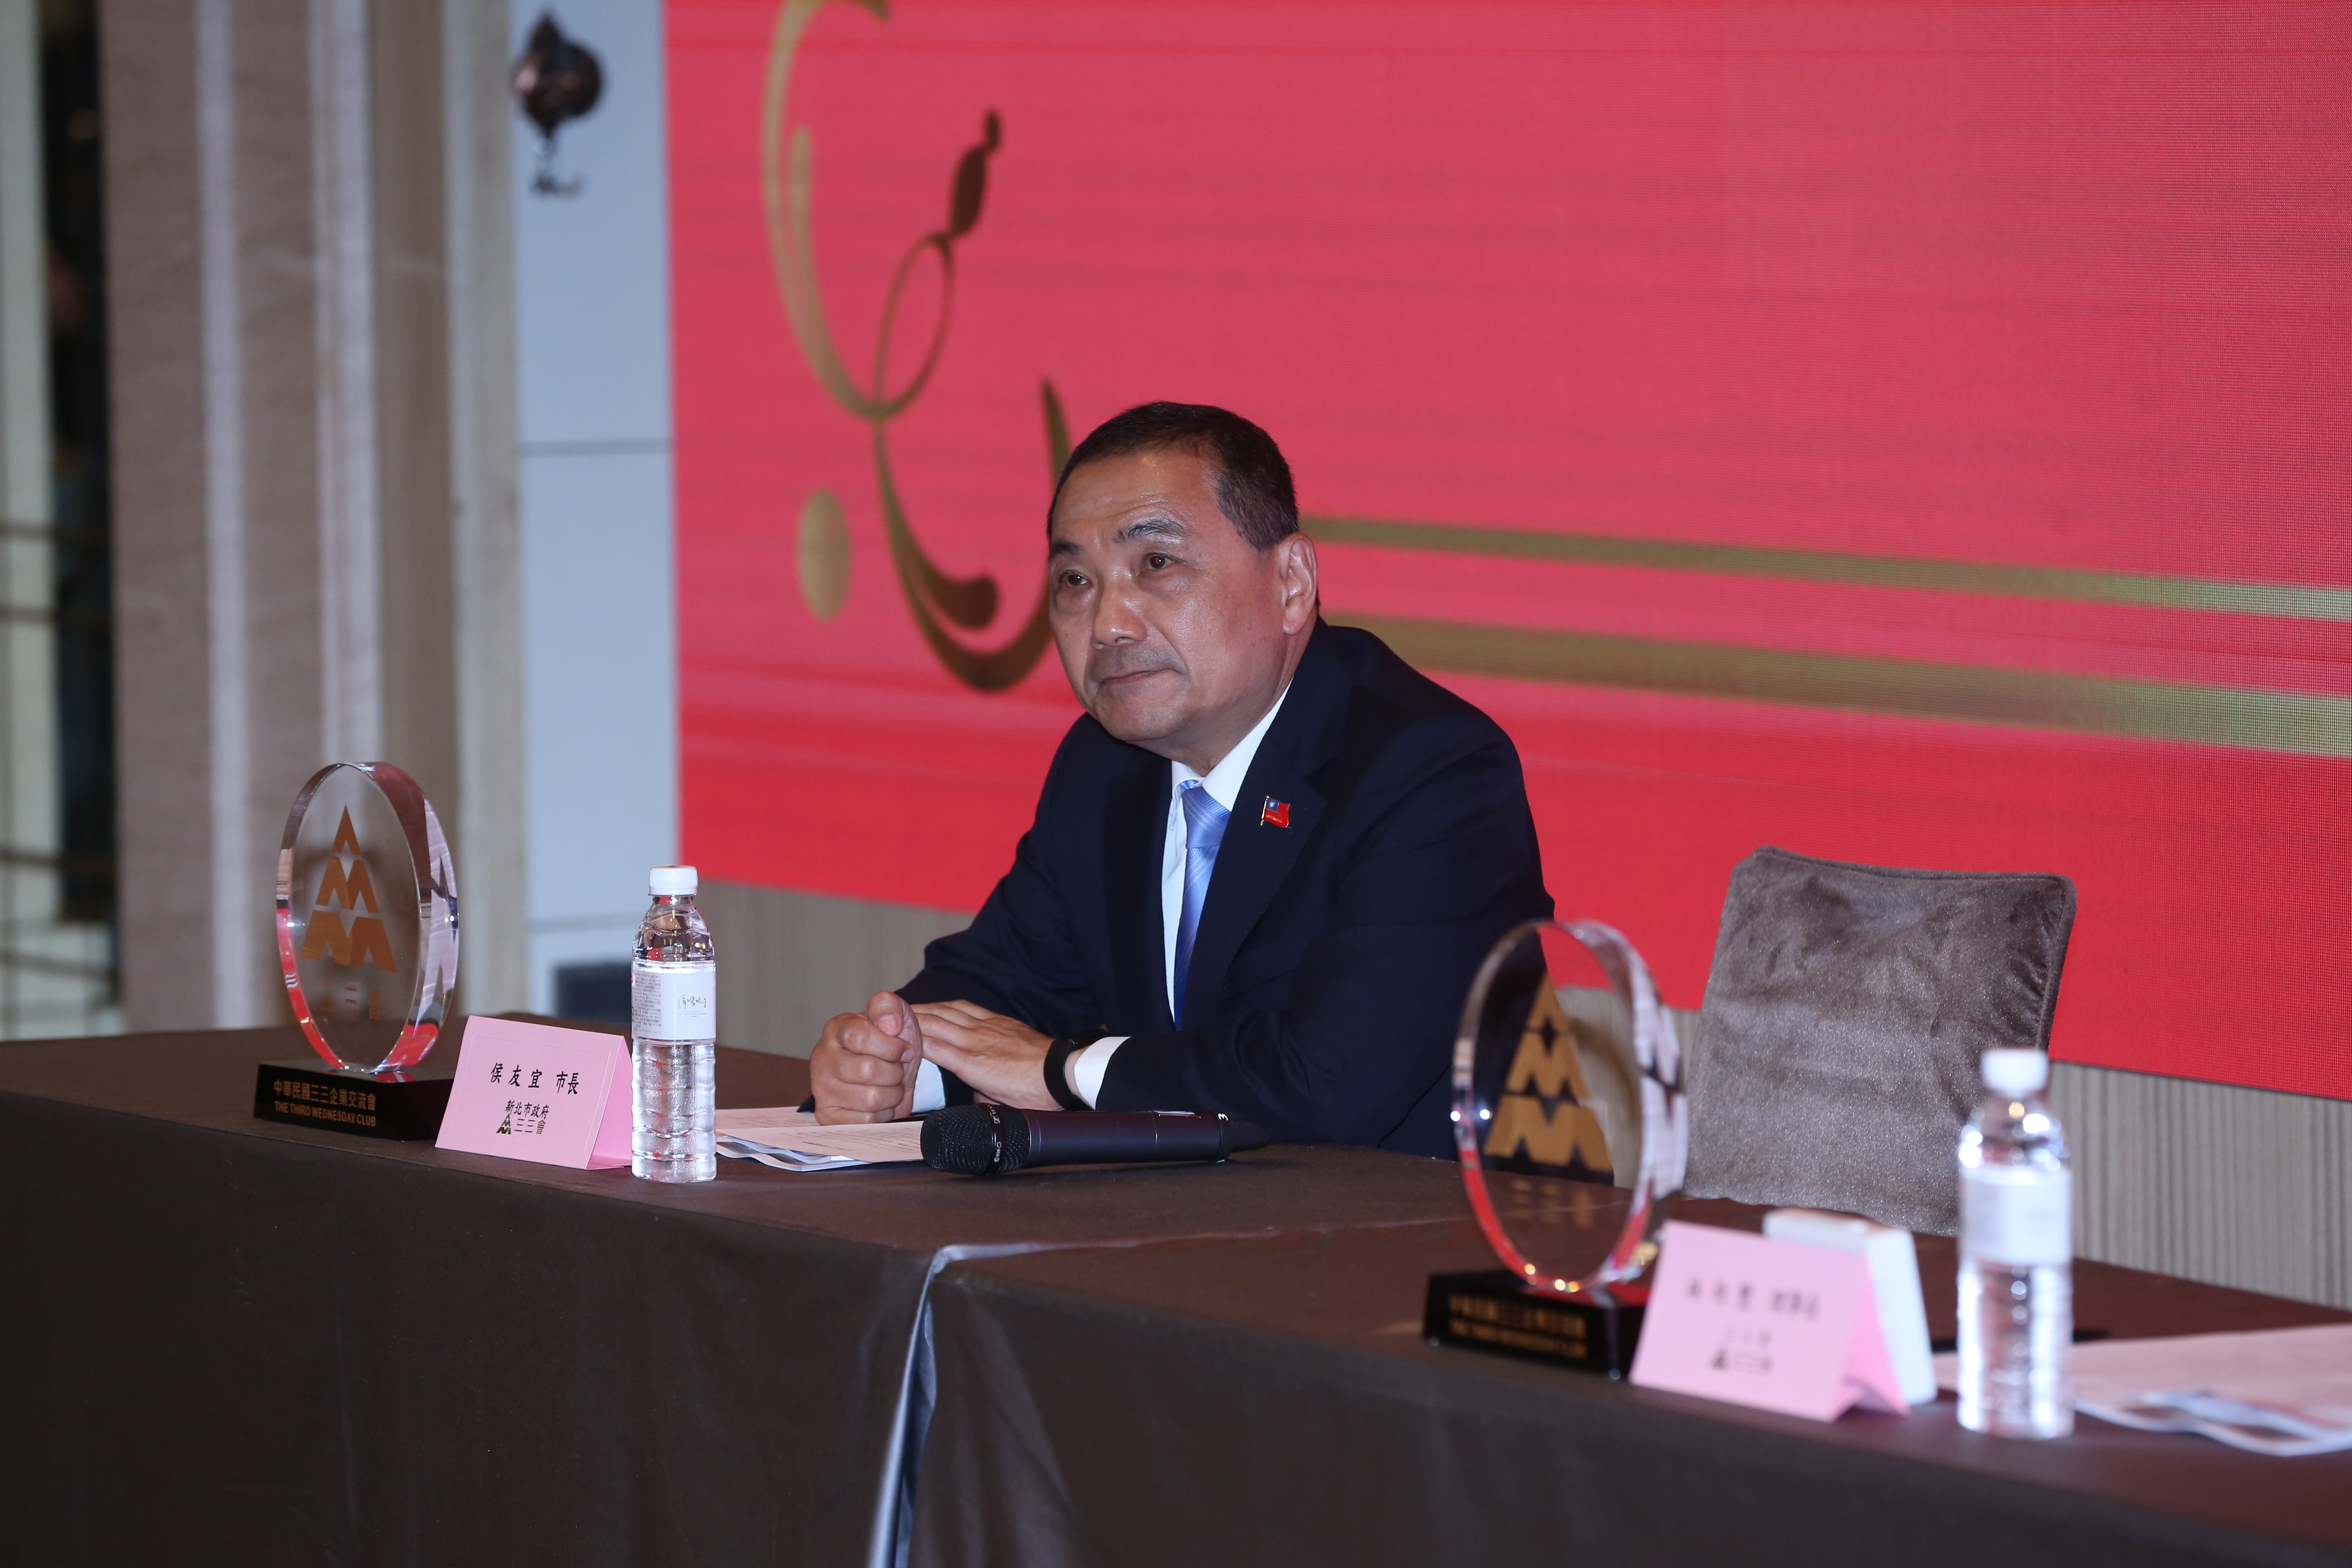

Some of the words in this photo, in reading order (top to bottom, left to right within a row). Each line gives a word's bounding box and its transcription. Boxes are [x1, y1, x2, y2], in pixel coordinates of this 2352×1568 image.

[274, 1079, 376, 1111] 中華民國三三企業交流會
[274, 1101, 289, 1113] THE
[290, 1103, 311, 1116] THIRD
[312, 1107, 355, 1123] WEDNESDAY
[356, 1114, 376, 1127] CLUB
[505, 1099, 549, 1119] 新北市政府
[514, 1118, 546, 1135] 三三會
